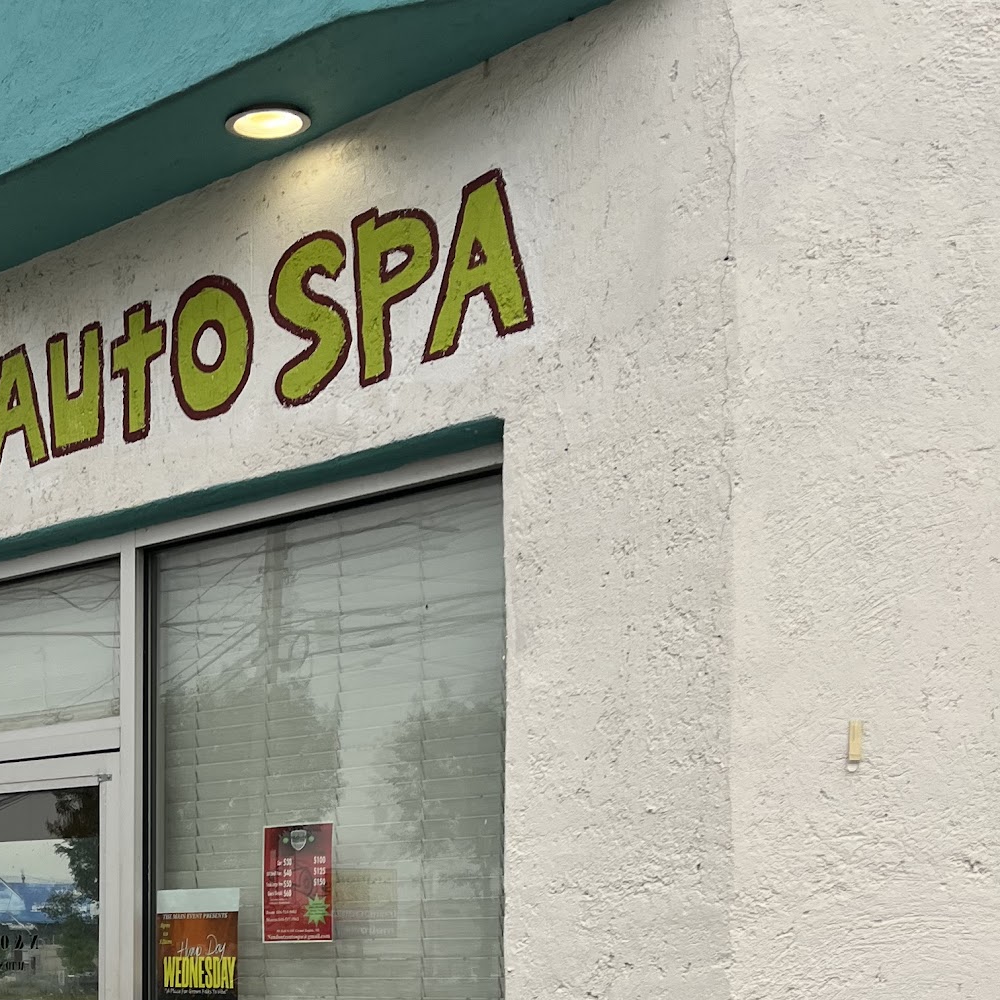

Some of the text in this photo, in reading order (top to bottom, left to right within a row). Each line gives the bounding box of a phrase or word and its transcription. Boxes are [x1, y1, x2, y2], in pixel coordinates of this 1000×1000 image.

[269, 168, 534, 408] SPA
[205, 934, 227, 962] Day
[163, 956, 236, 989] WEDNESDAY
